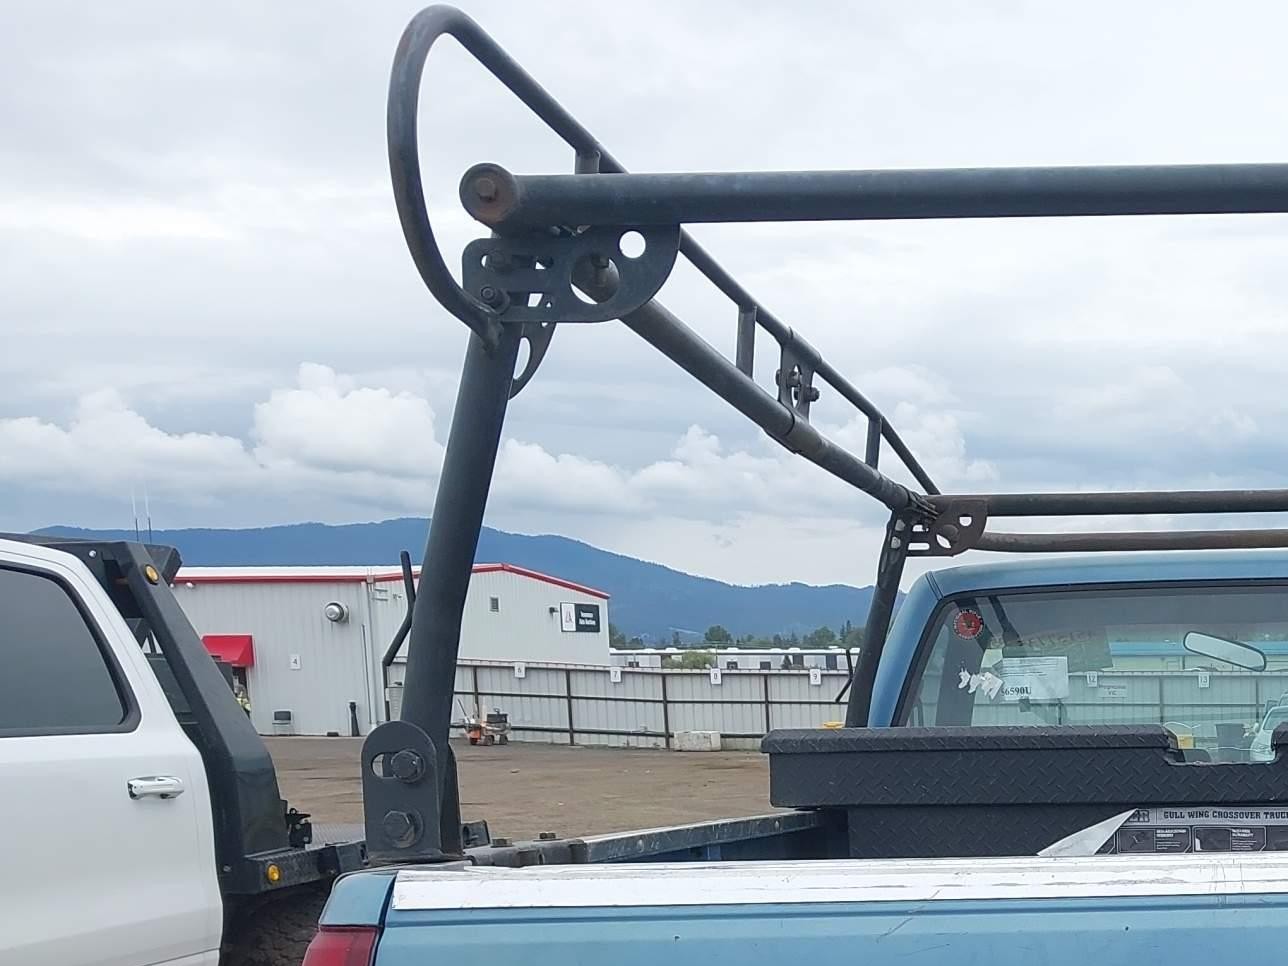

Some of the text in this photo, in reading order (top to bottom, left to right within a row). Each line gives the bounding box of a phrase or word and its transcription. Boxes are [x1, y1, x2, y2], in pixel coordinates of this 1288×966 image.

[1163, 811, 1185, 819] GULL
[1187, 810, 1210, 819] WING
[1212, 811, 1261, 820] CROSSOVER
